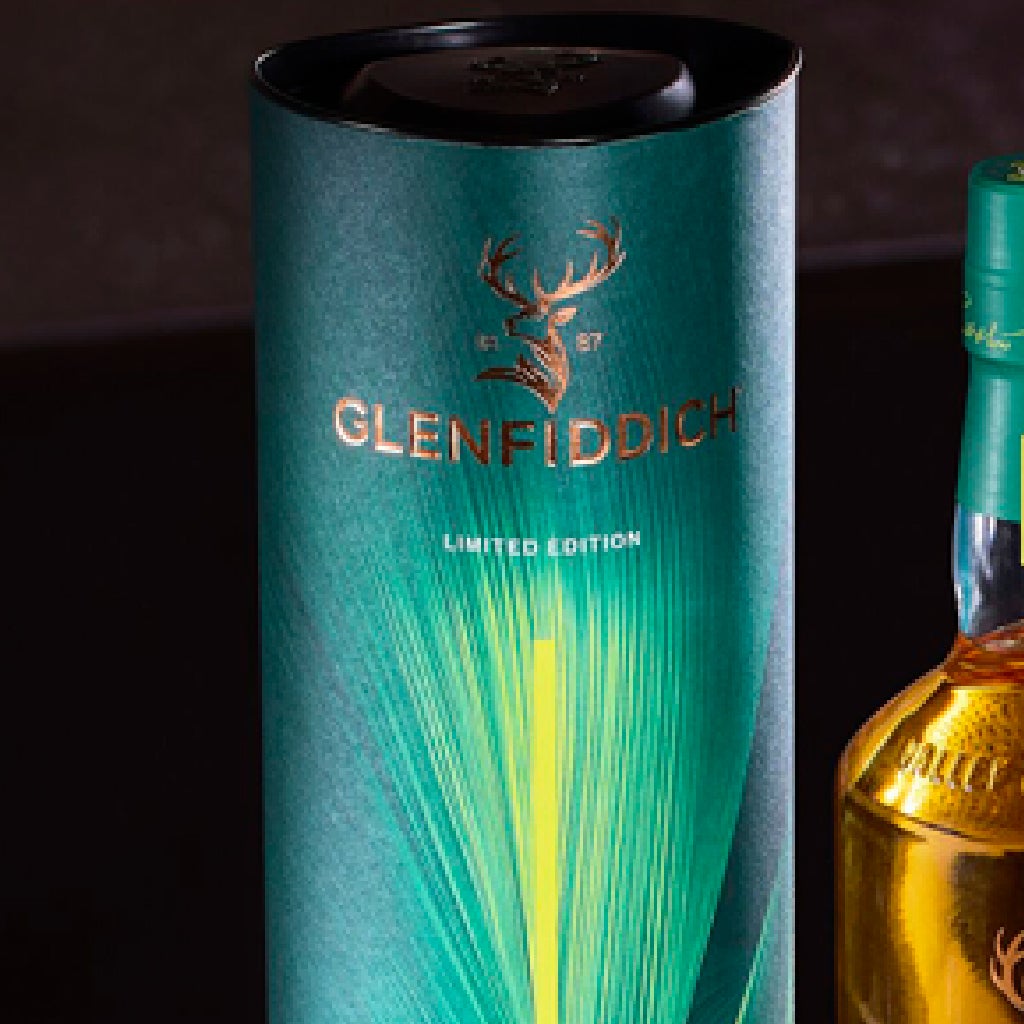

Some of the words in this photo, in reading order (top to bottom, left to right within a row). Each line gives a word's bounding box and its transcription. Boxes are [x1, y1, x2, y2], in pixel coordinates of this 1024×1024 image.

[333, 386, 743, 468] GLENFIDDICH
[442, 532, 539, 557] LIMITED
[547, 530, 642, 557] EDITION
